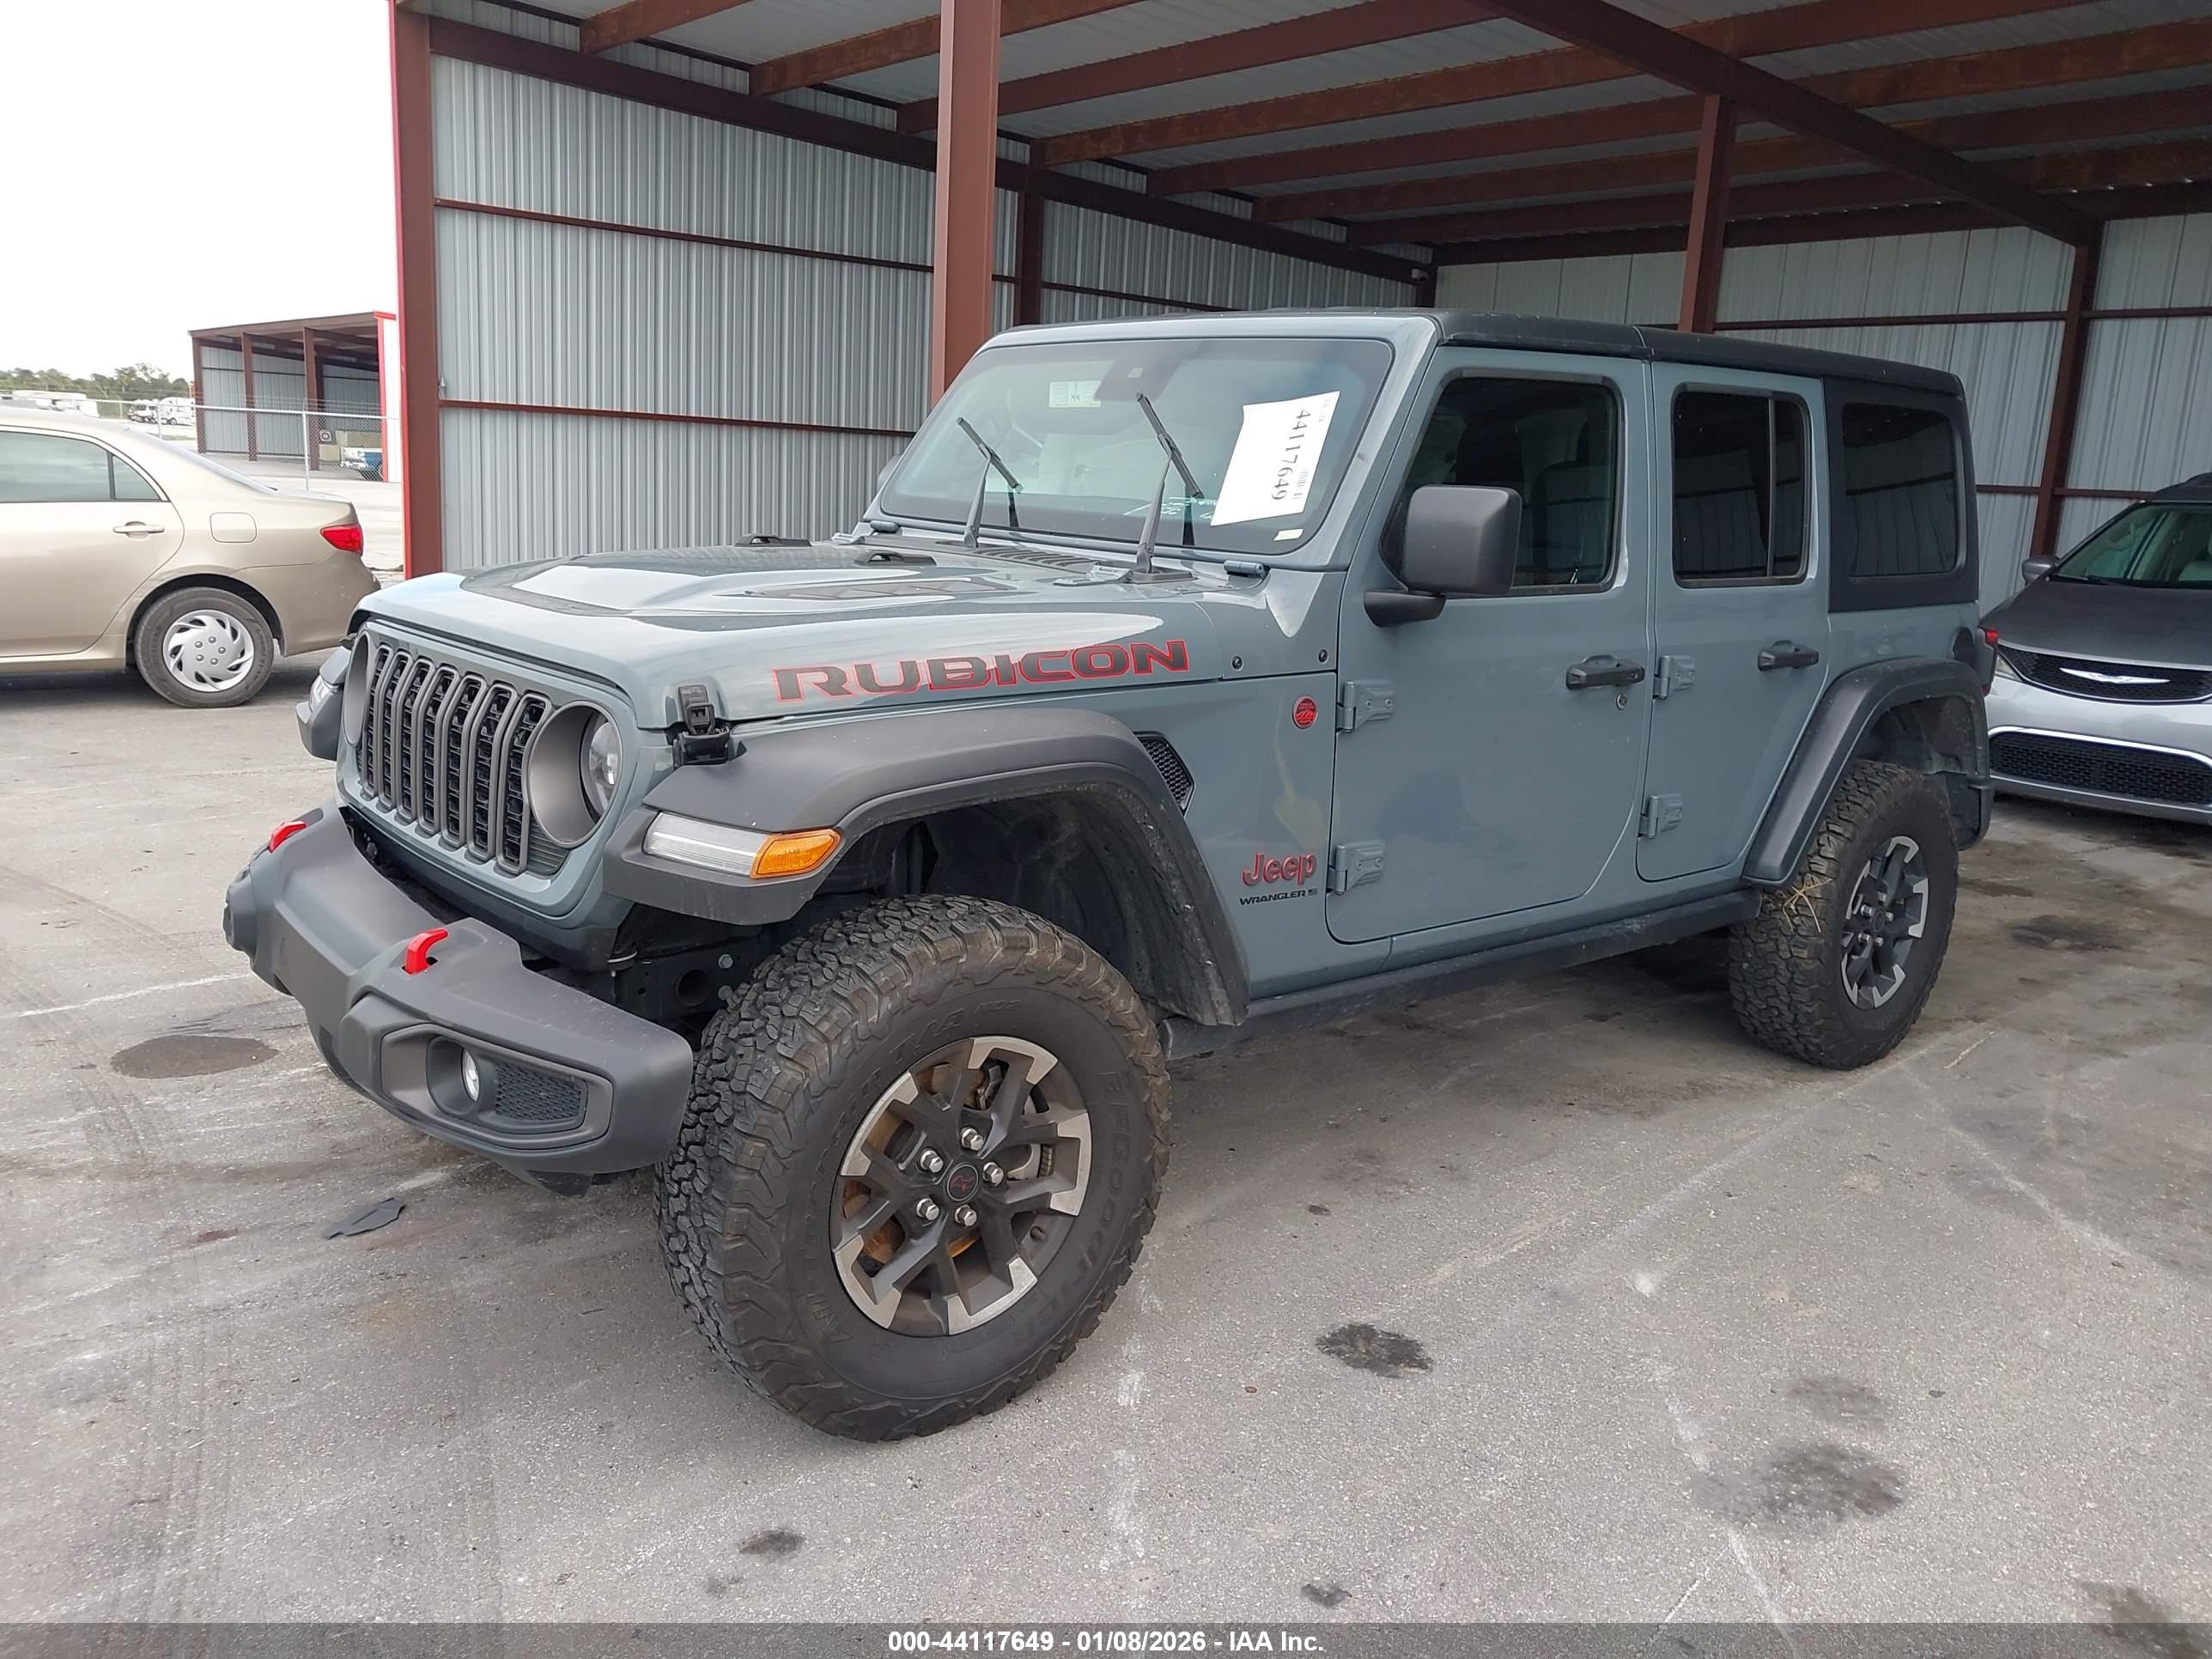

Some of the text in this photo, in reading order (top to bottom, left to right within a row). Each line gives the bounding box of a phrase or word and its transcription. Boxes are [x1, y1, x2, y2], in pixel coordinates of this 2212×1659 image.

[1272, 409, 1312, 501] 44117649
[771, 639, 1190, 702] RUBICON
[1242, 851, 1317, 886] Jeep
[1239, 890, 1306, 906] WRANGLER
